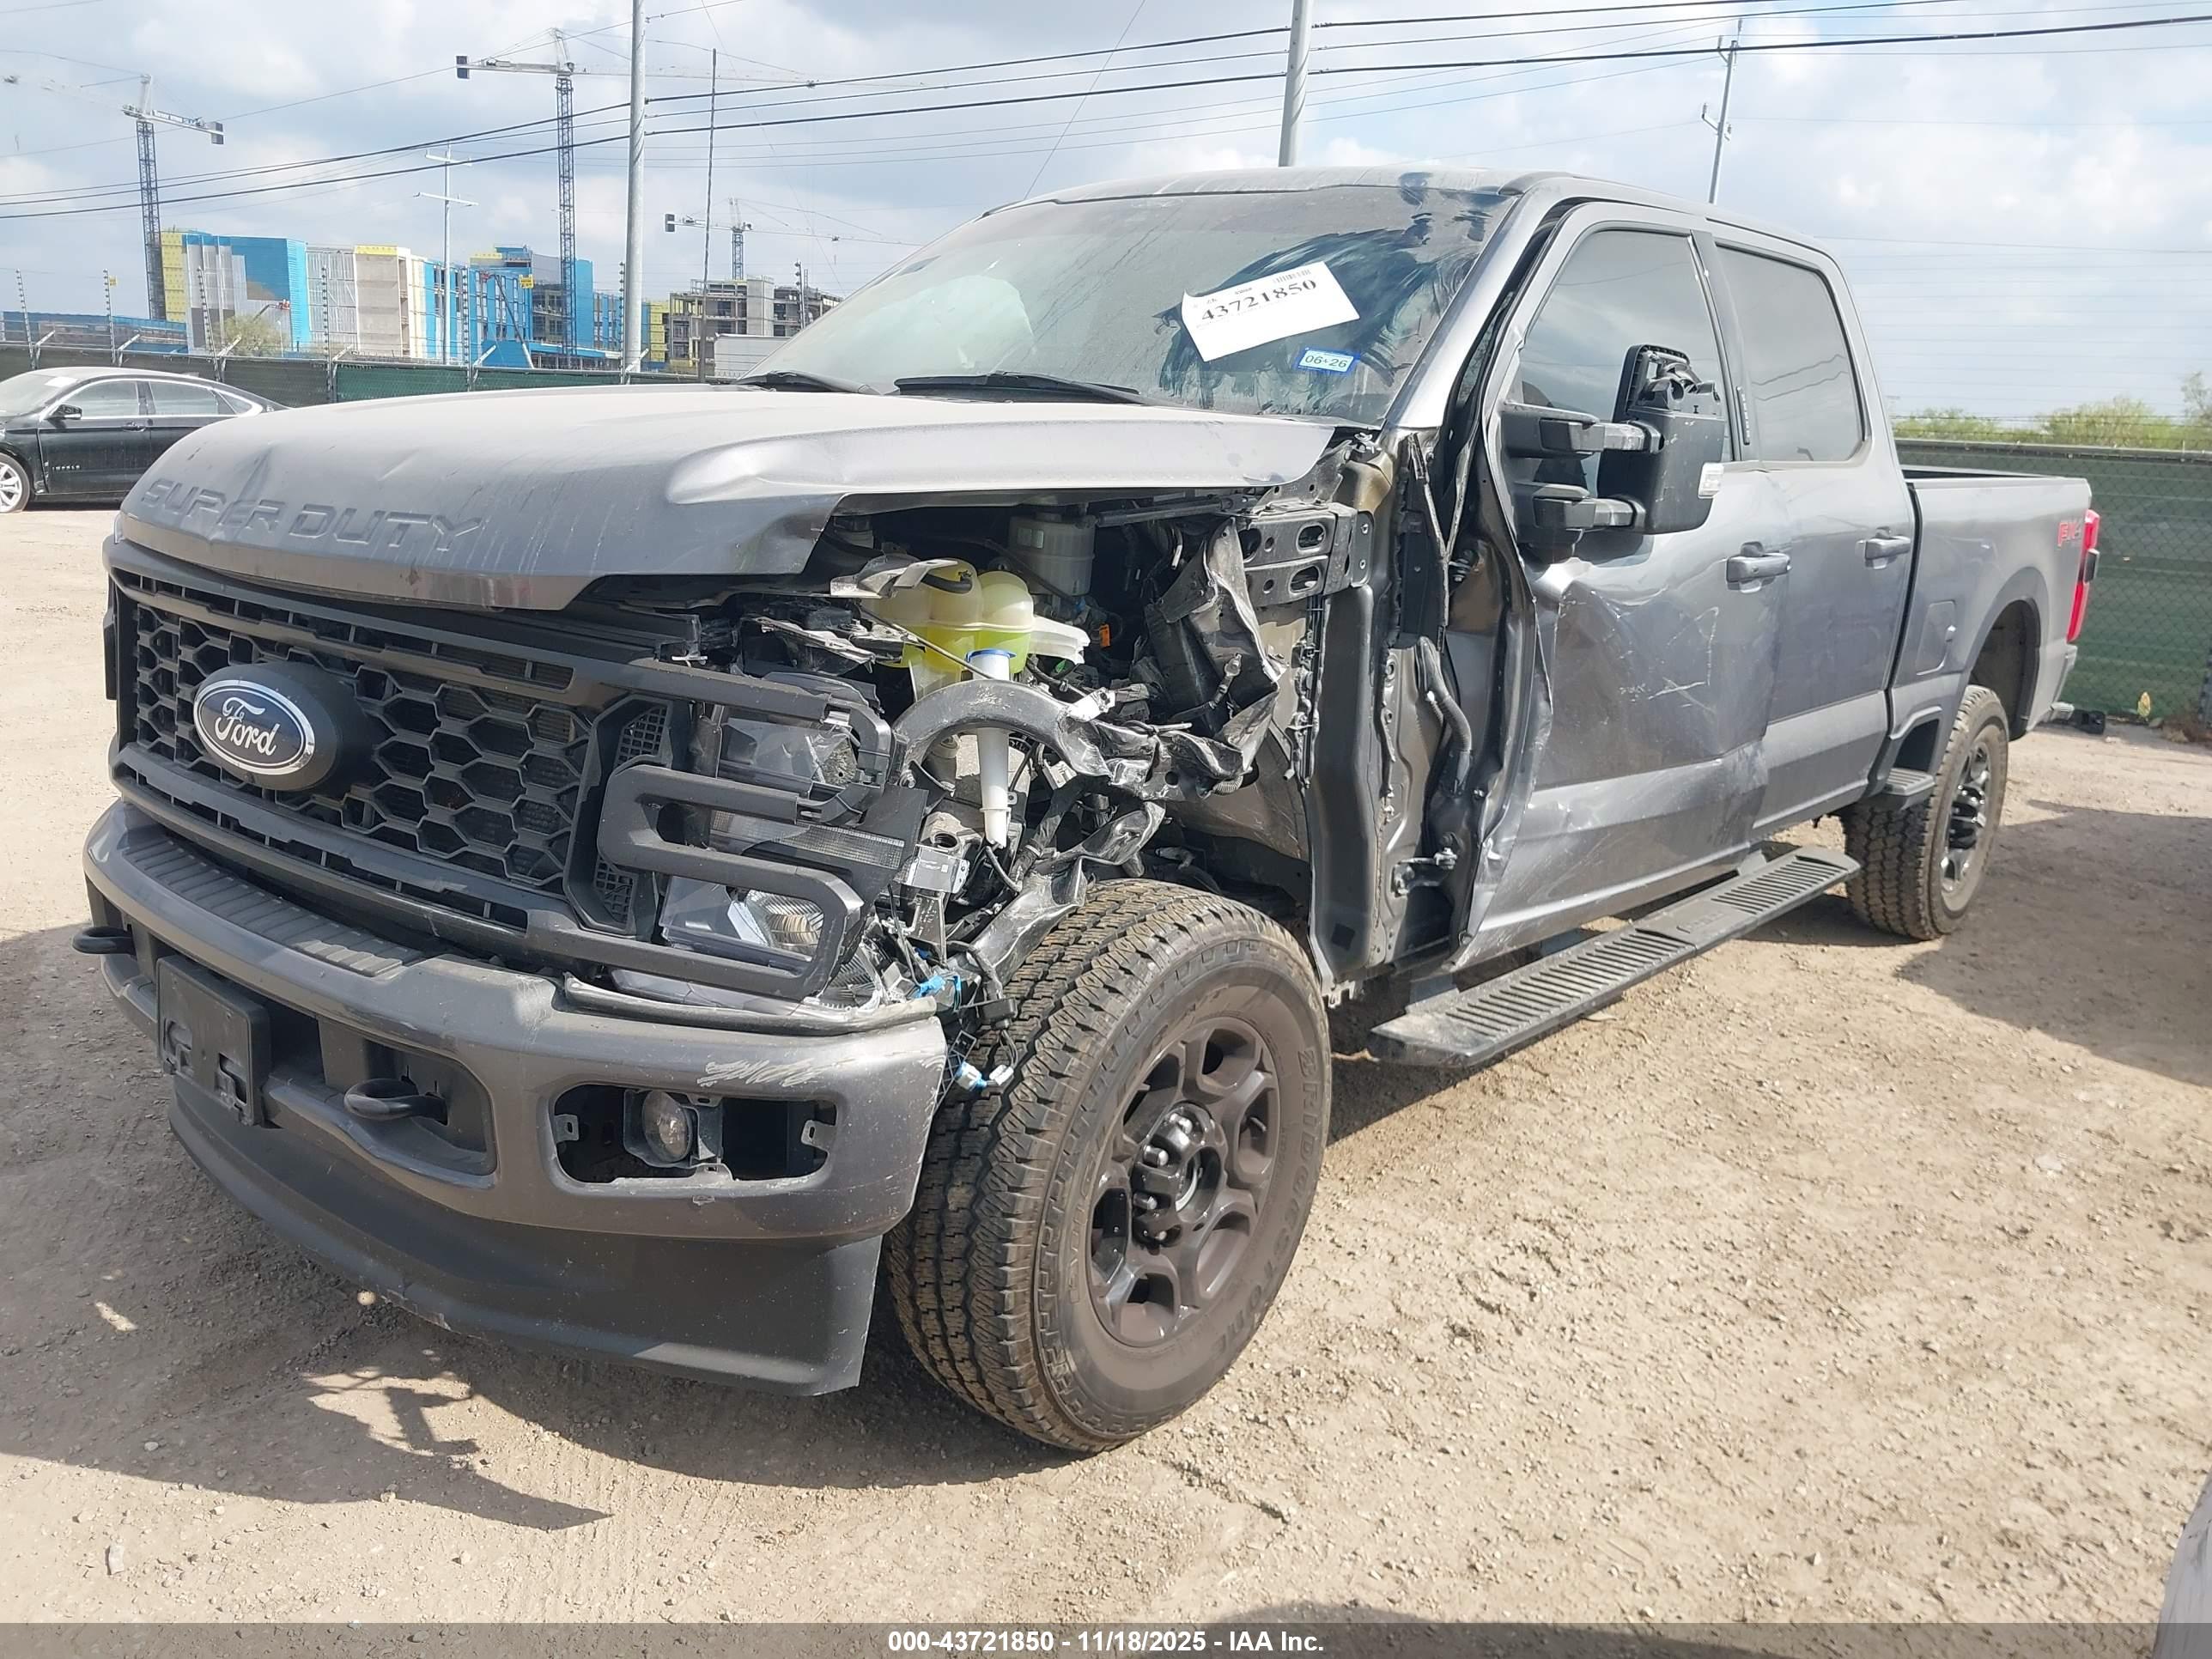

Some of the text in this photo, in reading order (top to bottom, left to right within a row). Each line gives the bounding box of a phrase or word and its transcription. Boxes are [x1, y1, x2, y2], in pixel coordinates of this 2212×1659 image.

[1201, 279, 1316, 320] 43721850
[141, 478, 486, 551] SUPER DUTY
[215, 696, 281, 757] Ford
